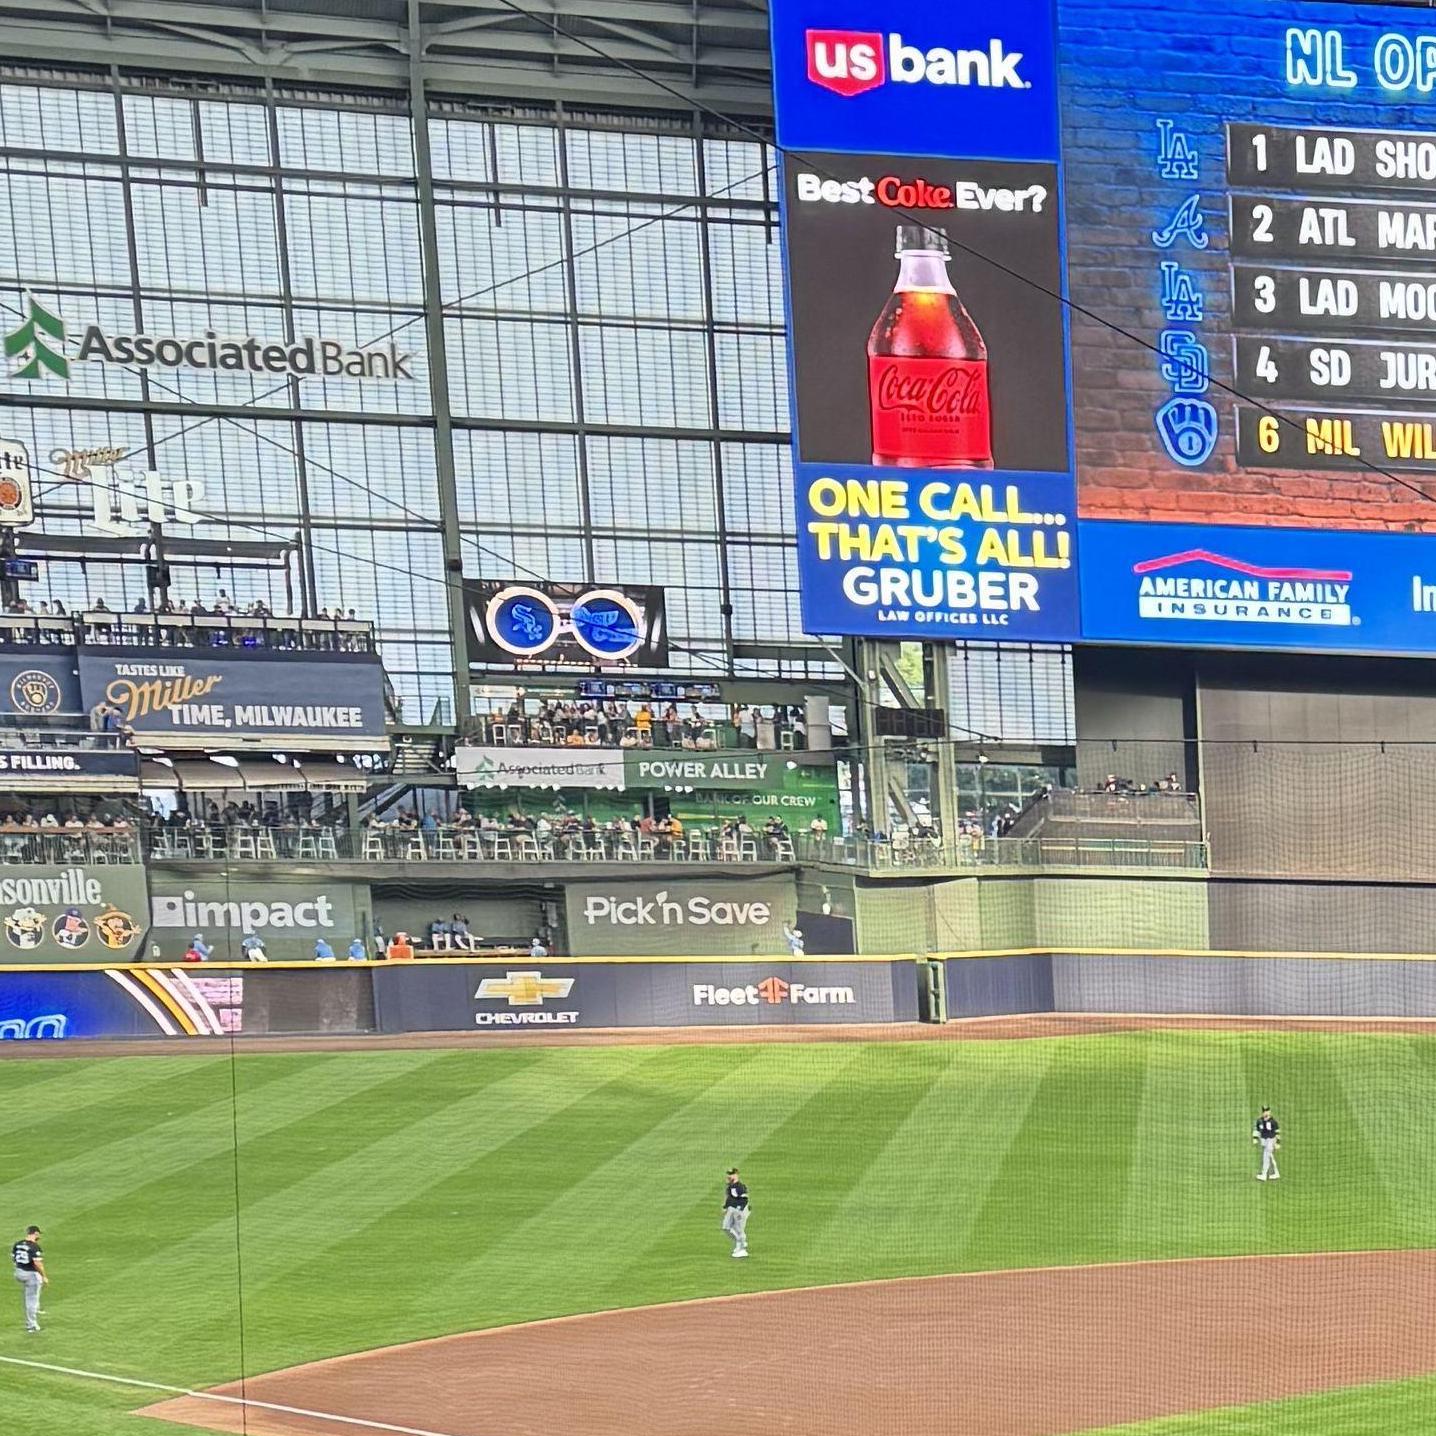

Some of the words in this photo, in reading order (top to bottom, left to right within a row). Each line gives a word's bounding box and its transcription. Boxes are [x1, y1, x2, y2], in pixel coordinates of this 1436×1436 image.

[815, 41, 877, 81] us
[1285, 28, 1358, 88] NL
[1251, 134, 1268, 171] 1
[1295, 135, 1355, 175] LAD
[797, 173, 875, 205] Best
[956, 181, 1047, 212] Ever?
[1252, 204, 1274, 243] 2
[1299, 207, 1356, 247] ATL
[1254, 275, 1276, 314] 3
[1299, 277, 1359, 317] LAD
[78, 324, 316, 376] Associated
[320, 338, 415, 381] Bank
[1255, 345, 1278, 384] 4
[1309, 348, 1353, 387] SD
[1258, 415, 1279, 453] 6
[1306, 418, 1360, 457] MIL
[808, 477, 909, 519] ONE
[807, 522, 967, 565] THAT'S
[976, 527, 1071, 569] ALL!
[842, 566, 1041, 611] GRUBER
[1138, 577, 1259, 601] AMERICAN
[1267, 581, 1349, 604] FAMILY
[1155, 602, 1333, 620] INSURANCE
[115, 664, 158, 677] TASTES
[159, 666, 185, 677] LIKE
[106, 675, 223, 722] Miller
[234, 705, 363, 728] MILWAUKEE
[638, 762, 707, 780] POWER
[710, 762, 768, 780] ALLEY
[185, 890, 334, 934] impact
[584, 895, 656, 925] Pick
[688, 895, 770, 925] Save
[693, 984, 758, 1005] Fleet
[790, 984, 855, 1004] Farm
[475, 1011, 579, 1024] CHEVROLET
